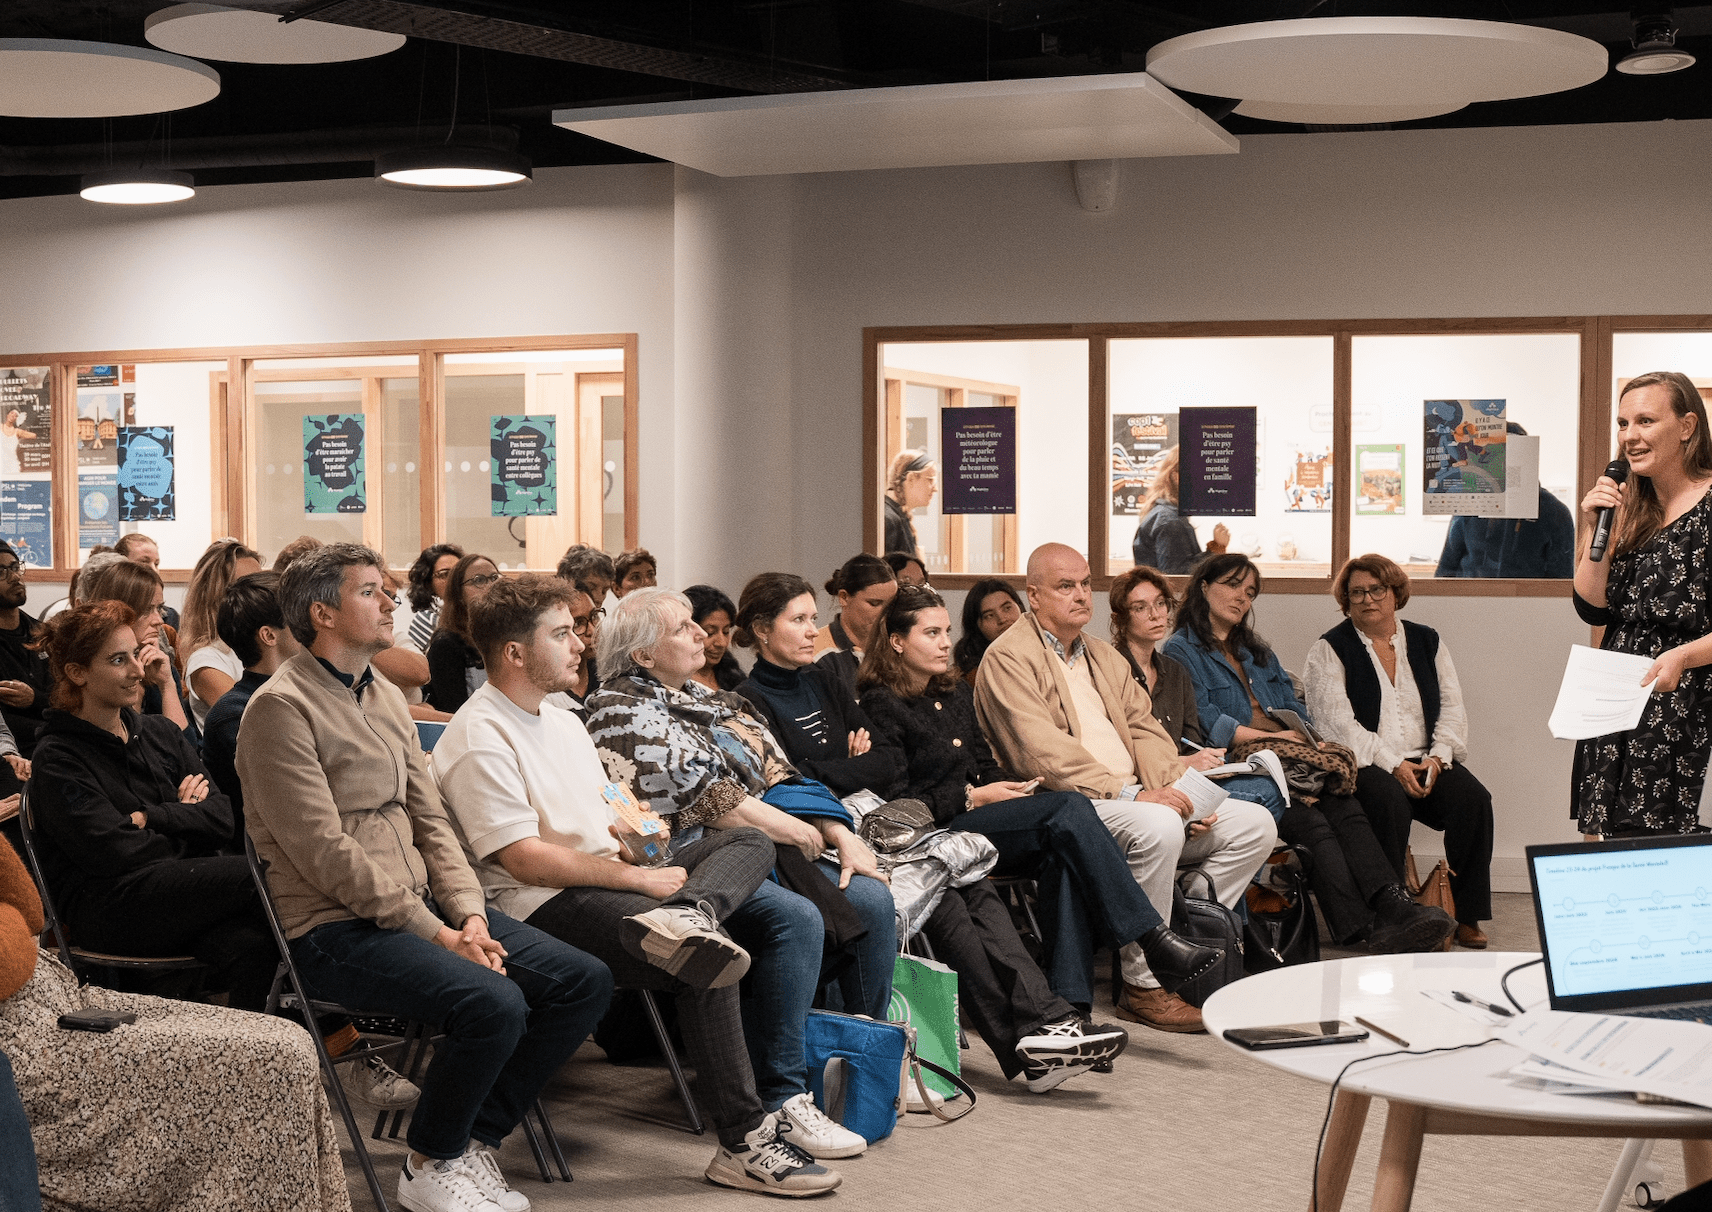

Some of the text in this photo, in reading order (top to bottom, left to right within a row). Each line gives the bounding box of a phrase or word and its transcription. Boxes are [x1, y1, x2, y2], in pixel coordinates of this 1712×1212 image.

[1216, 448, 1234, 456] parler
[975, 456, 990, 464] pluie
[760, 1155, 780, 1169] N
